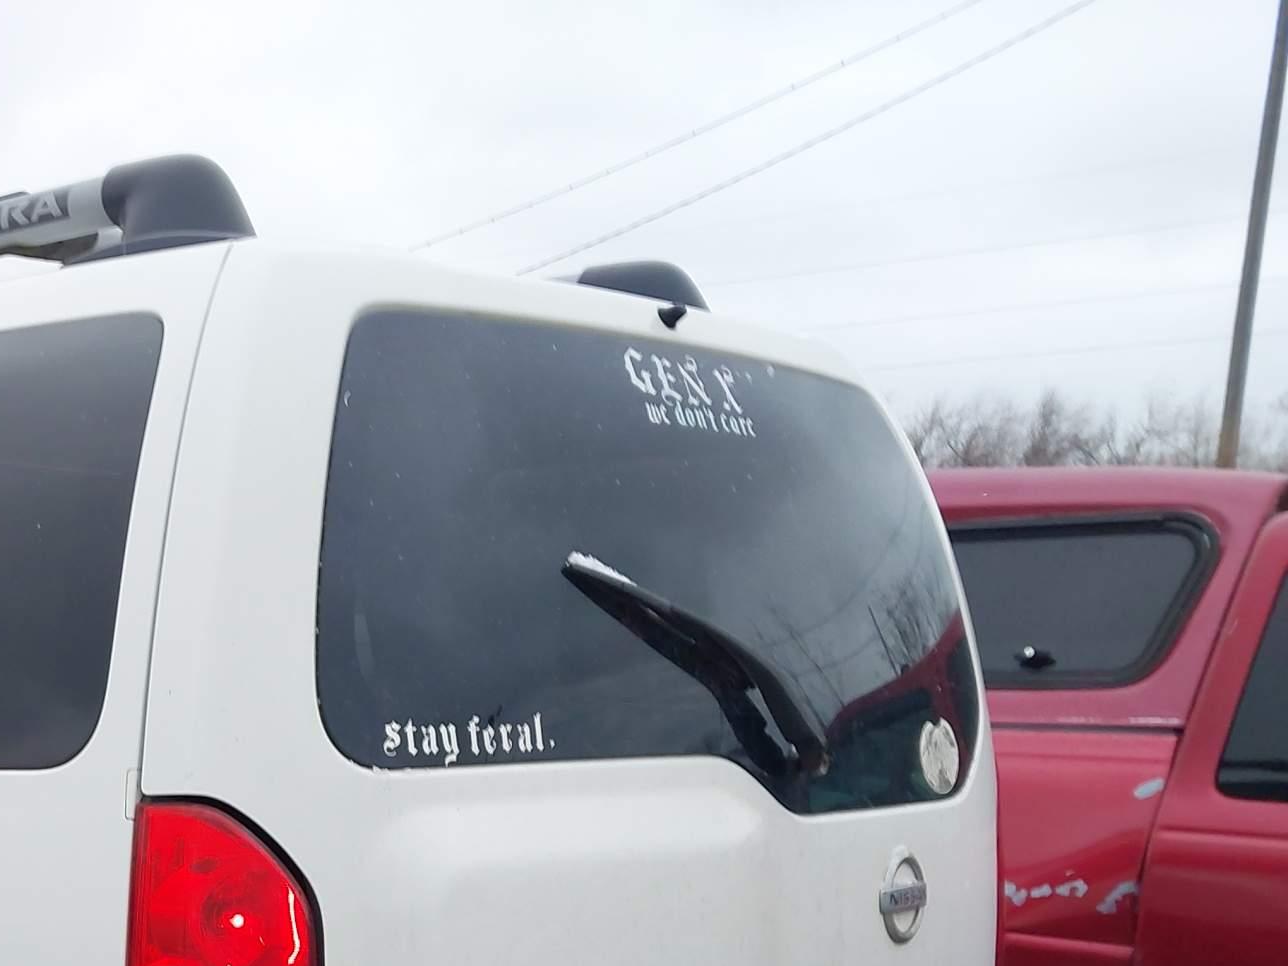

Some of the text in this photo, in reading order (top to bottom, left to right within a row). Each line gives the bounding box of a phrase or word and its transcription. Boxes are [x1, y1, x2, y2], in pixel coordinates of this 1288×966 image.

[623, 346, 713, 407] GEN
[644, 400, 757, 438] we don't care
[383, 711, 556, 767] stay feral.
